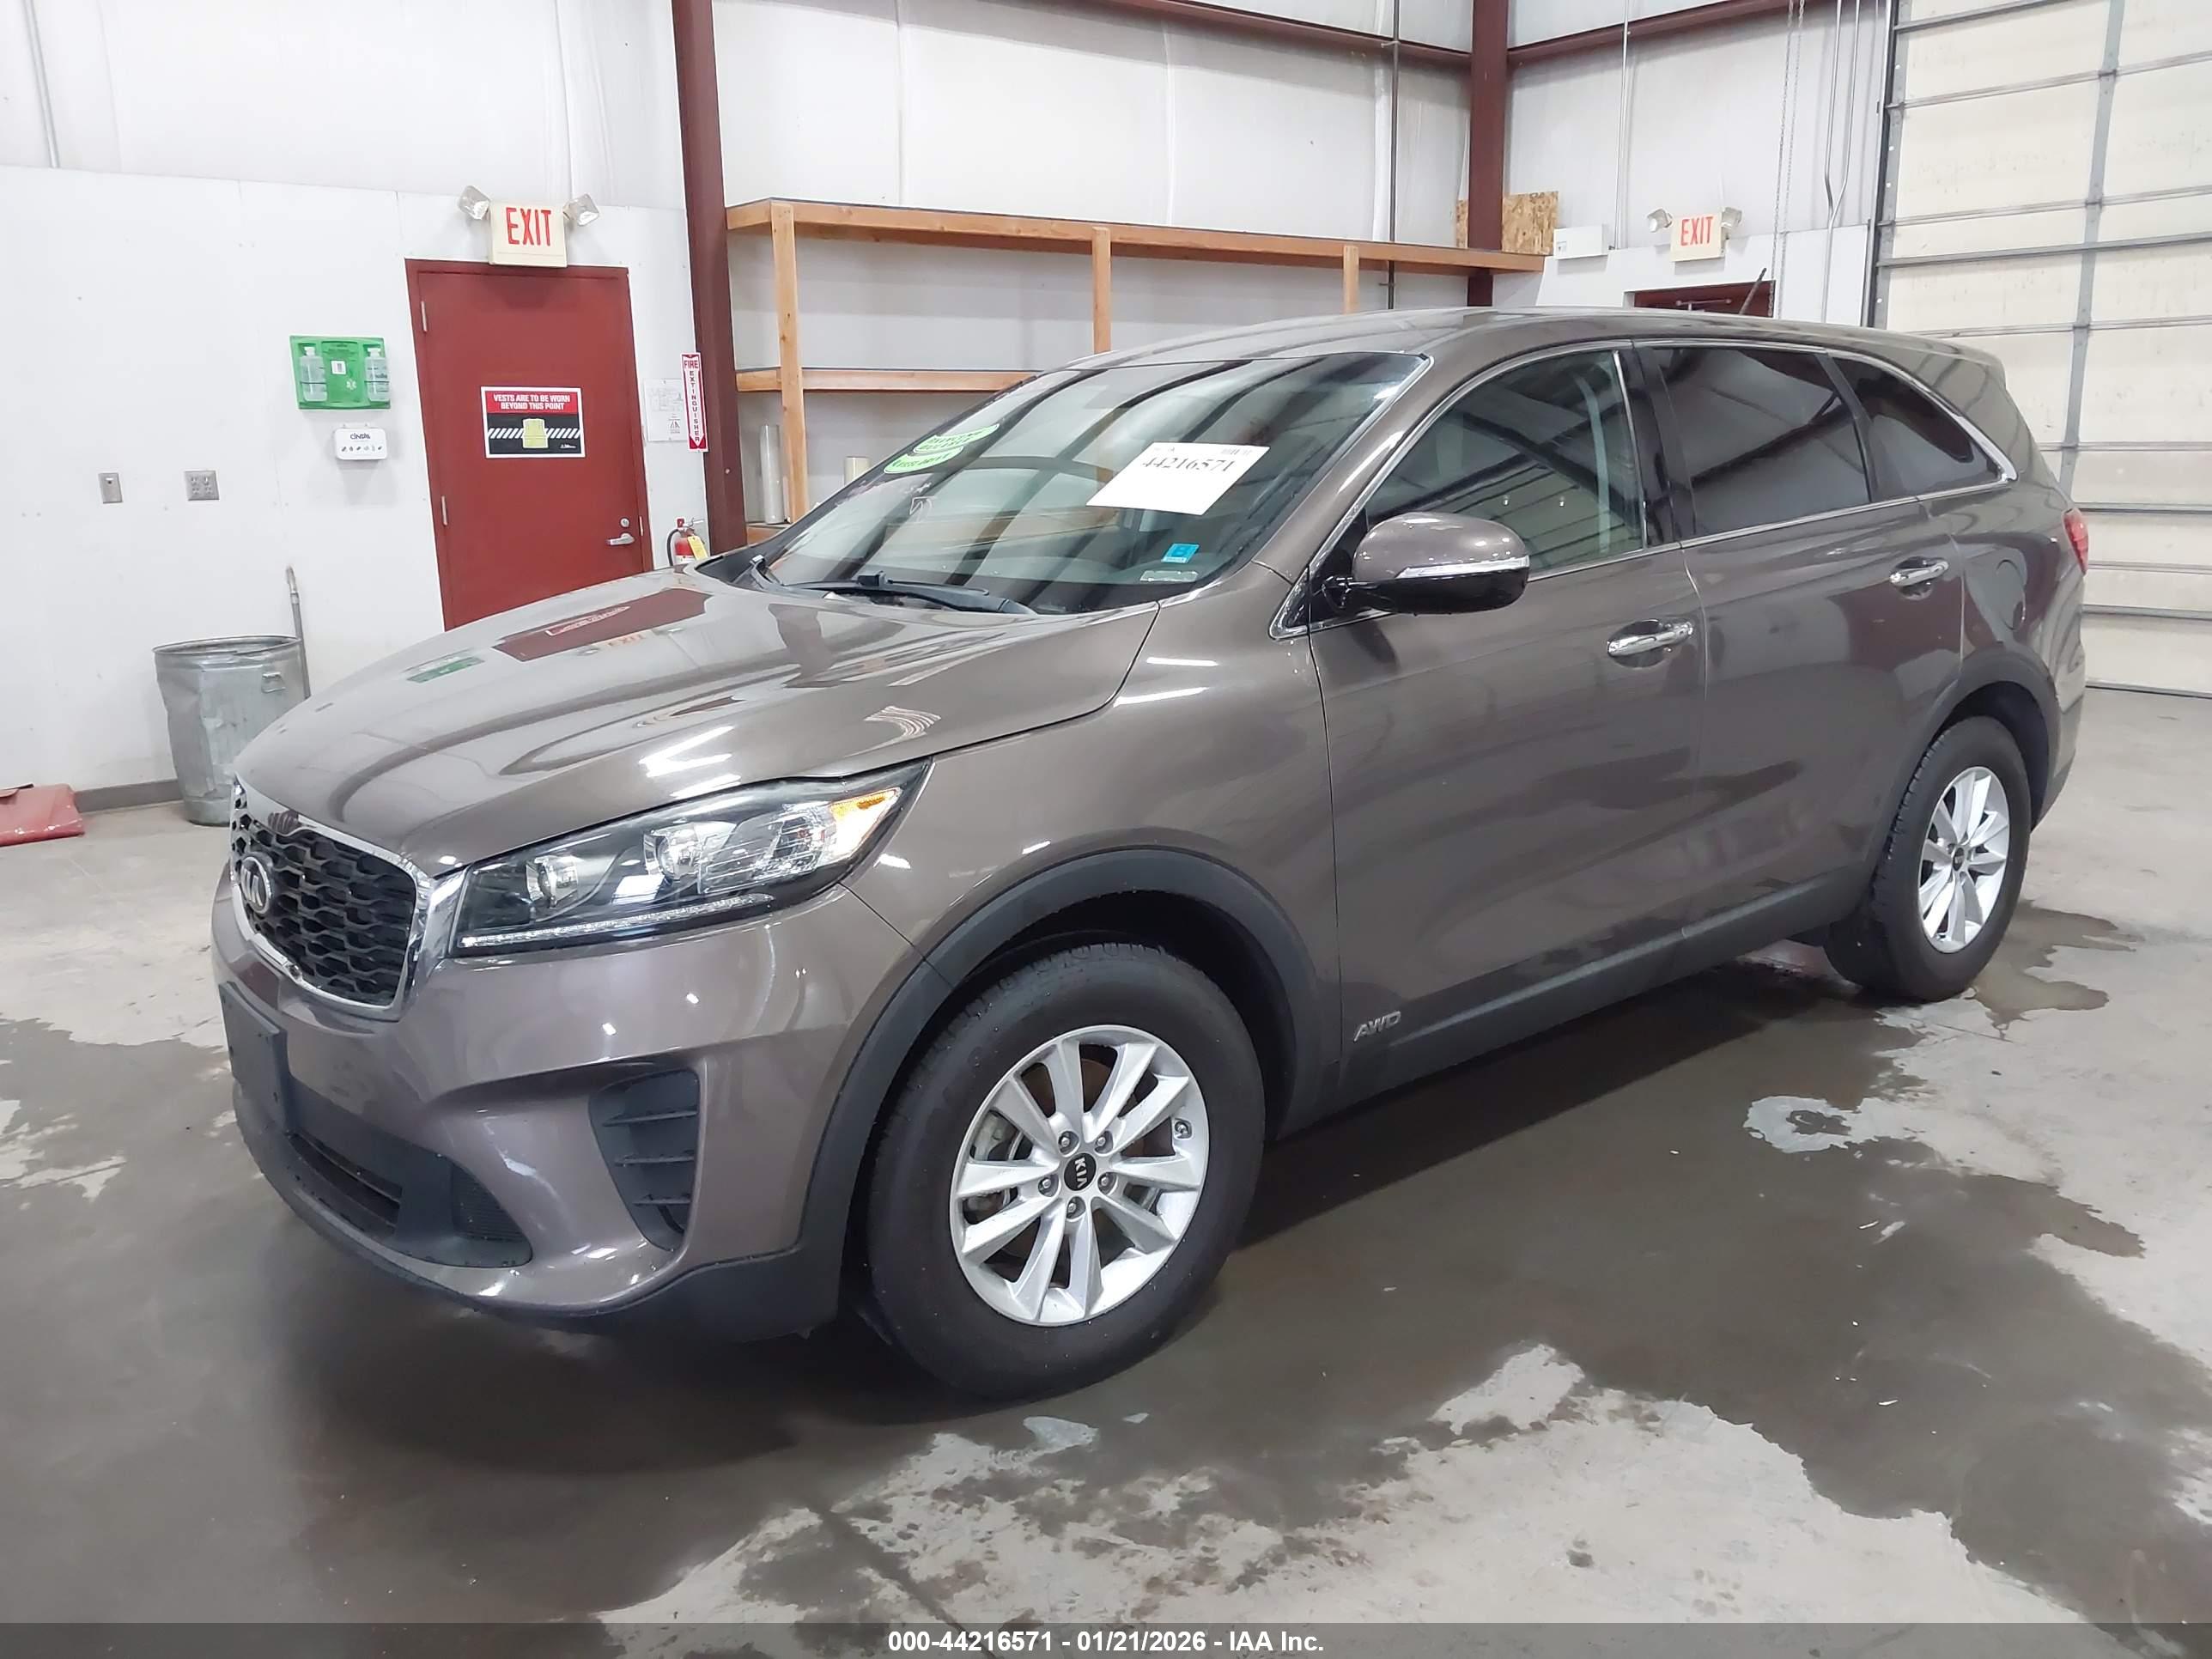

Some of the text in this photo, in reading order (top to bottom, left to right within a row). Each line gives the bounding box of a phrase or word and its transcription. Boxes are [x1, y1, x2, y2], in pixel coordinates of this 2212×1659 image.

[506, 207, 552, 246] EXIT
[1680, 217, 1714, 246] EXIT
[684, 360, 699, 369] FIRE
[689, 370, 700, 442] EXTINGUISHER
[1140, 457, 1237, 472] 44216571
[1352, 1011, 1402, 1042] AWD
[1074, 1157, 1089, 1188] KIA
